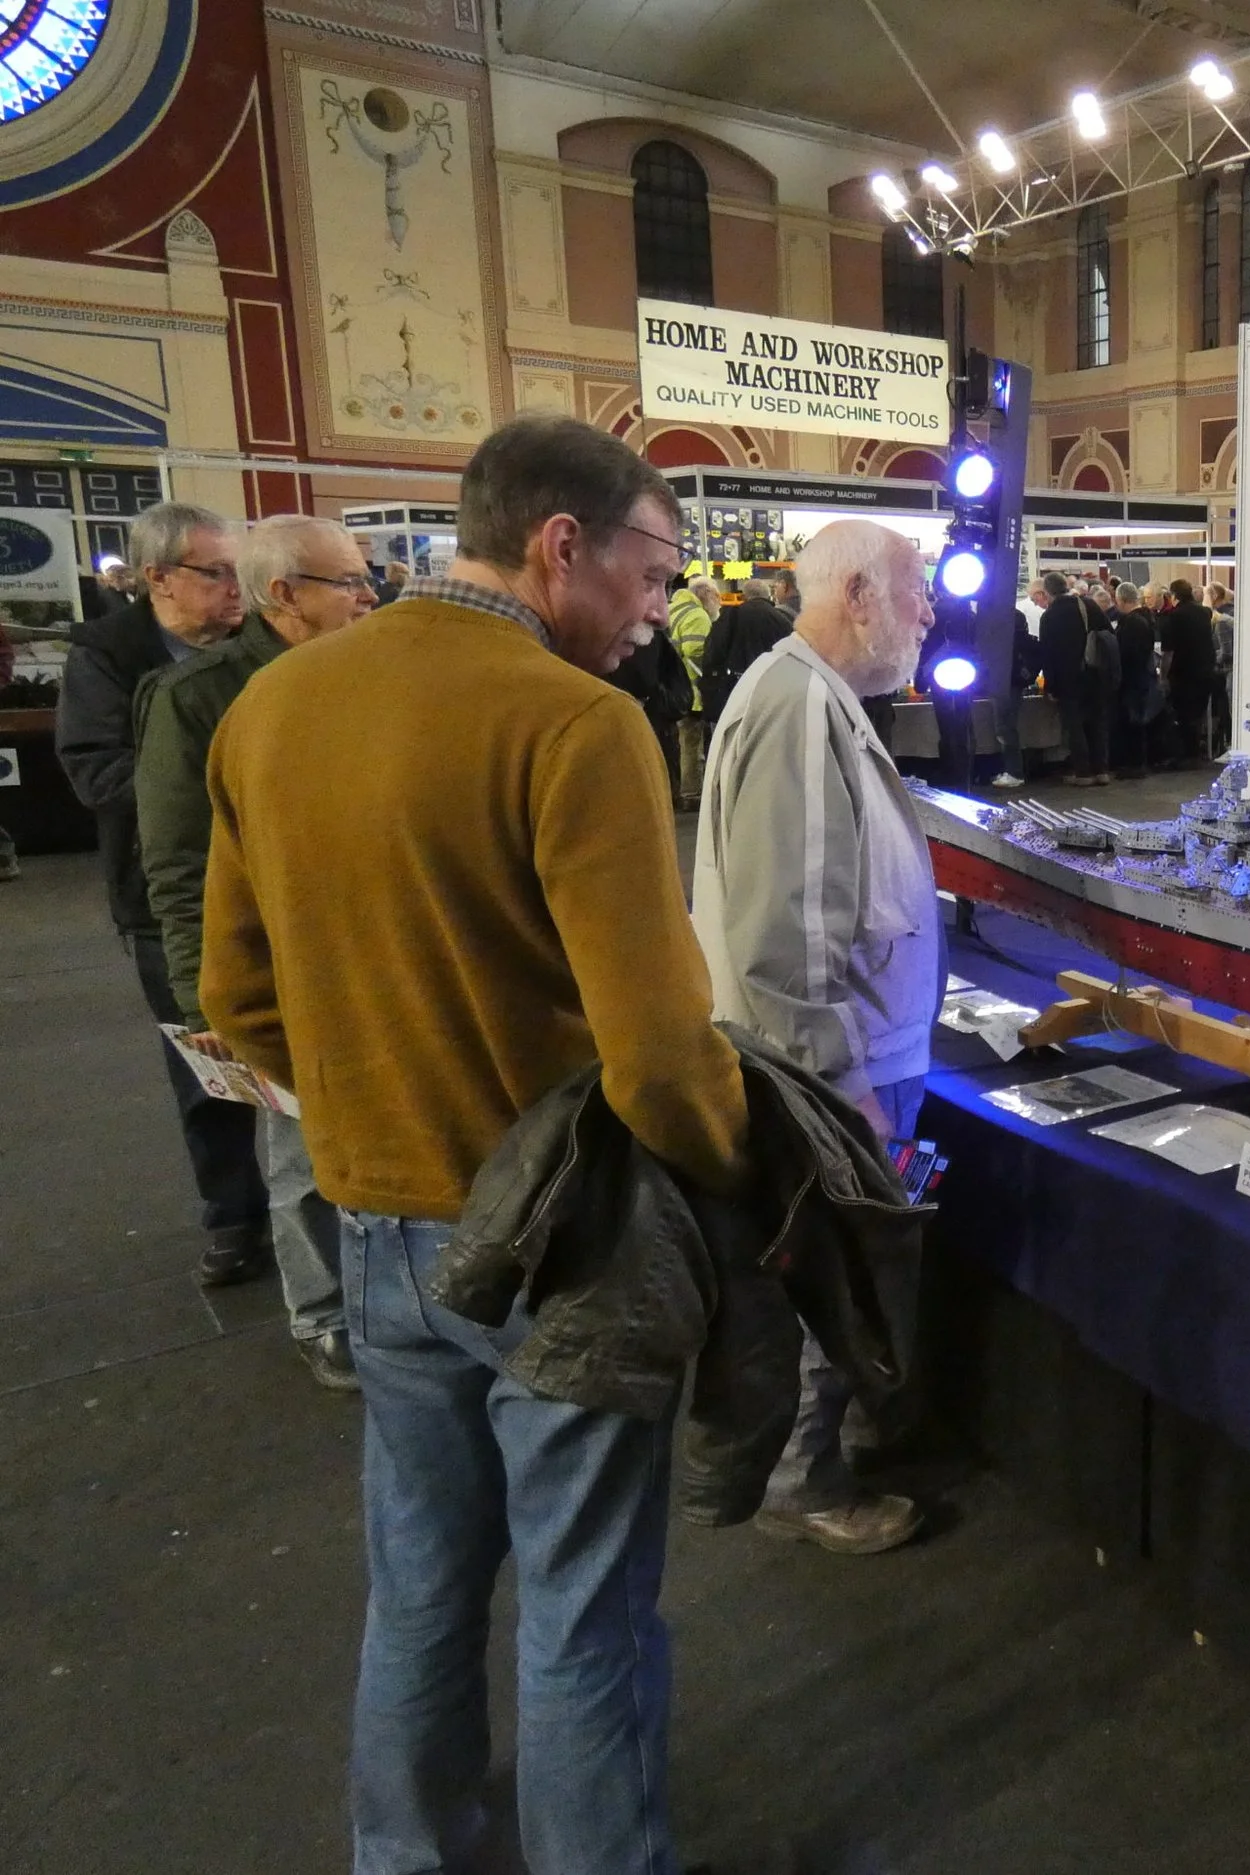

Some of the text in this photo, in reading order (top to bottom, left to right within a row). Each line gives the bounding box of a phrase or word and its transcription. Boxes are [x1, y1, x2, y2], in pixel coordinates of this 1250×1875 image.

[645, 317, 944, 379] HOME AND WORKSHOP
[725, 360, 881, 401] MACHINERY
[656, 385, 939, 430] QUALITY USED MACHINE TOOLS
[750, 485, 772, 494] HOME
[774, 486, 791, 495] AND
[793, 487, 835, 498] WORKSHOP
[836, 490, 877, 500] MACHINERY
